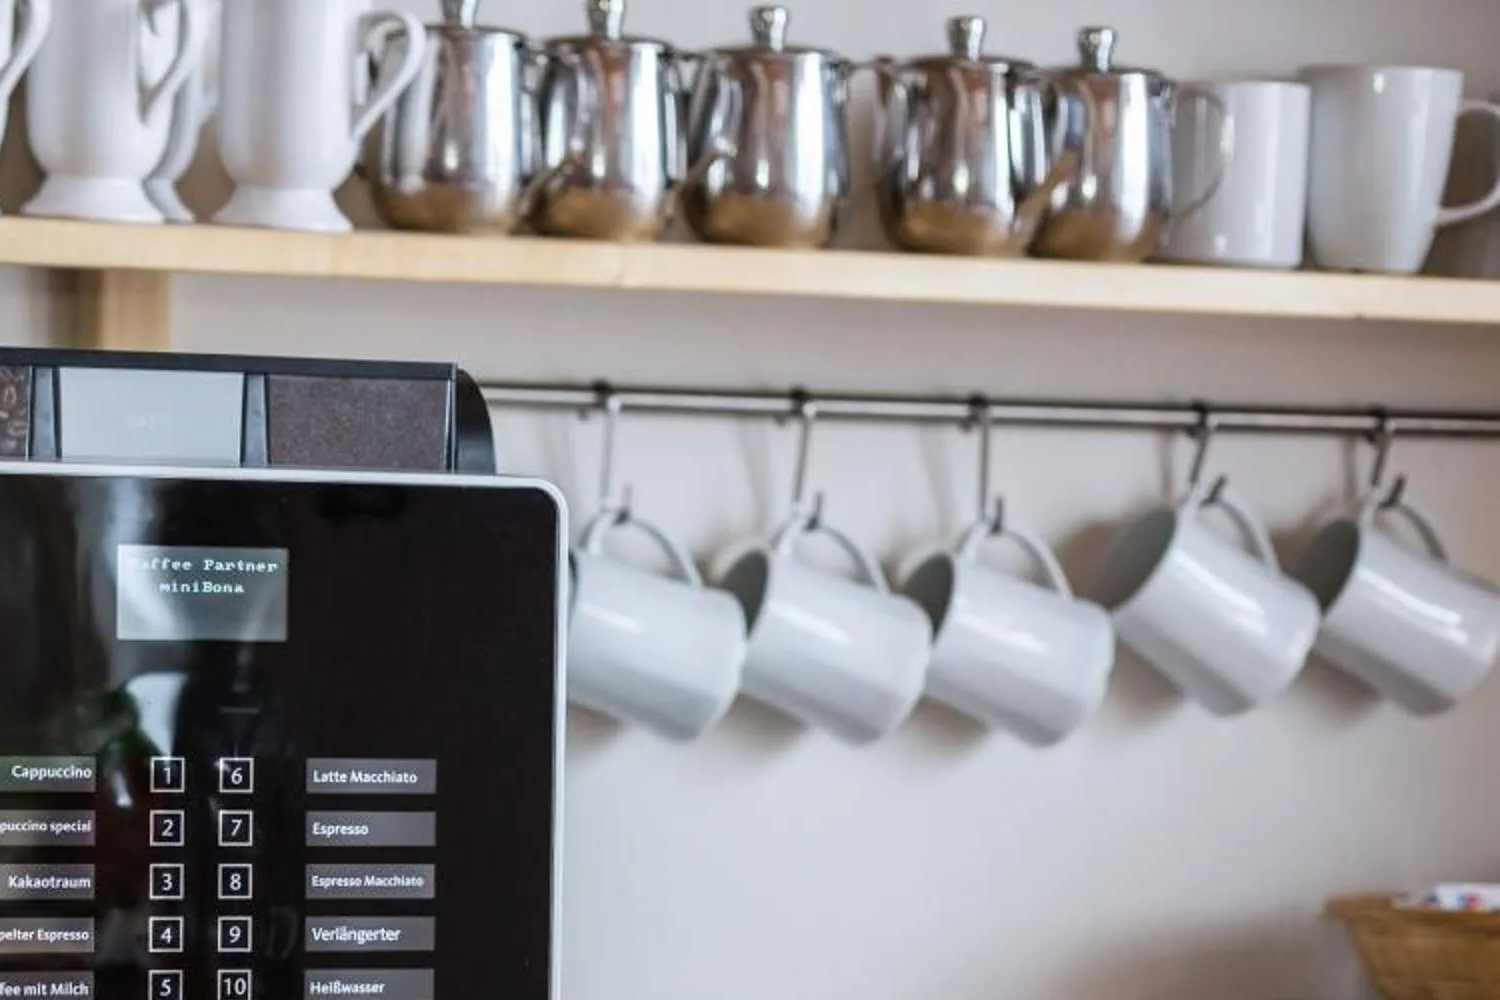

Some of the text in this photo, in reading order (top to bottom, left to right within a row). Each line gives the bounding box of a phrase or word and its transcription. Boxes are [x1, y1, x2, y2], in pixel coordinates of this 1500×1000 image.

[133, 557, 279, 573] affee Partner
[159, 581, 245, 594] miniBona
[11, 764, 93, 781] Cappuccino
[162, 767, 172, 785] 1
[230, 767, 243, 785] 6
[313, 769, 418, 784] Latte Macchiato
[49, 819, 93, 835] special
[161, 818, 174, 837] 2
[231, 819, 243, 837] 7
[312, 821, 369, 838] Espresso
[7, 874, 91, 889] Kakaotraum
[161, 873, 173, 891] 3
[229, 873, 242, 891] 8
[311, 875, 425, 889] Espresso Macchiato
[36, 928, 90, 943] Espresso
[160, 927, 173, 944] 4
[229, 925, 241, 943] 9
[311, 925, 401, 945] Verlängerter
[23, 982, 48, 996] mit
[49, 981, 89, 996] Milch
[159, 978, 172, 997] 5
[223, 977, 247, 996] 10
[310, 979, 386, 995] Heißwasser
